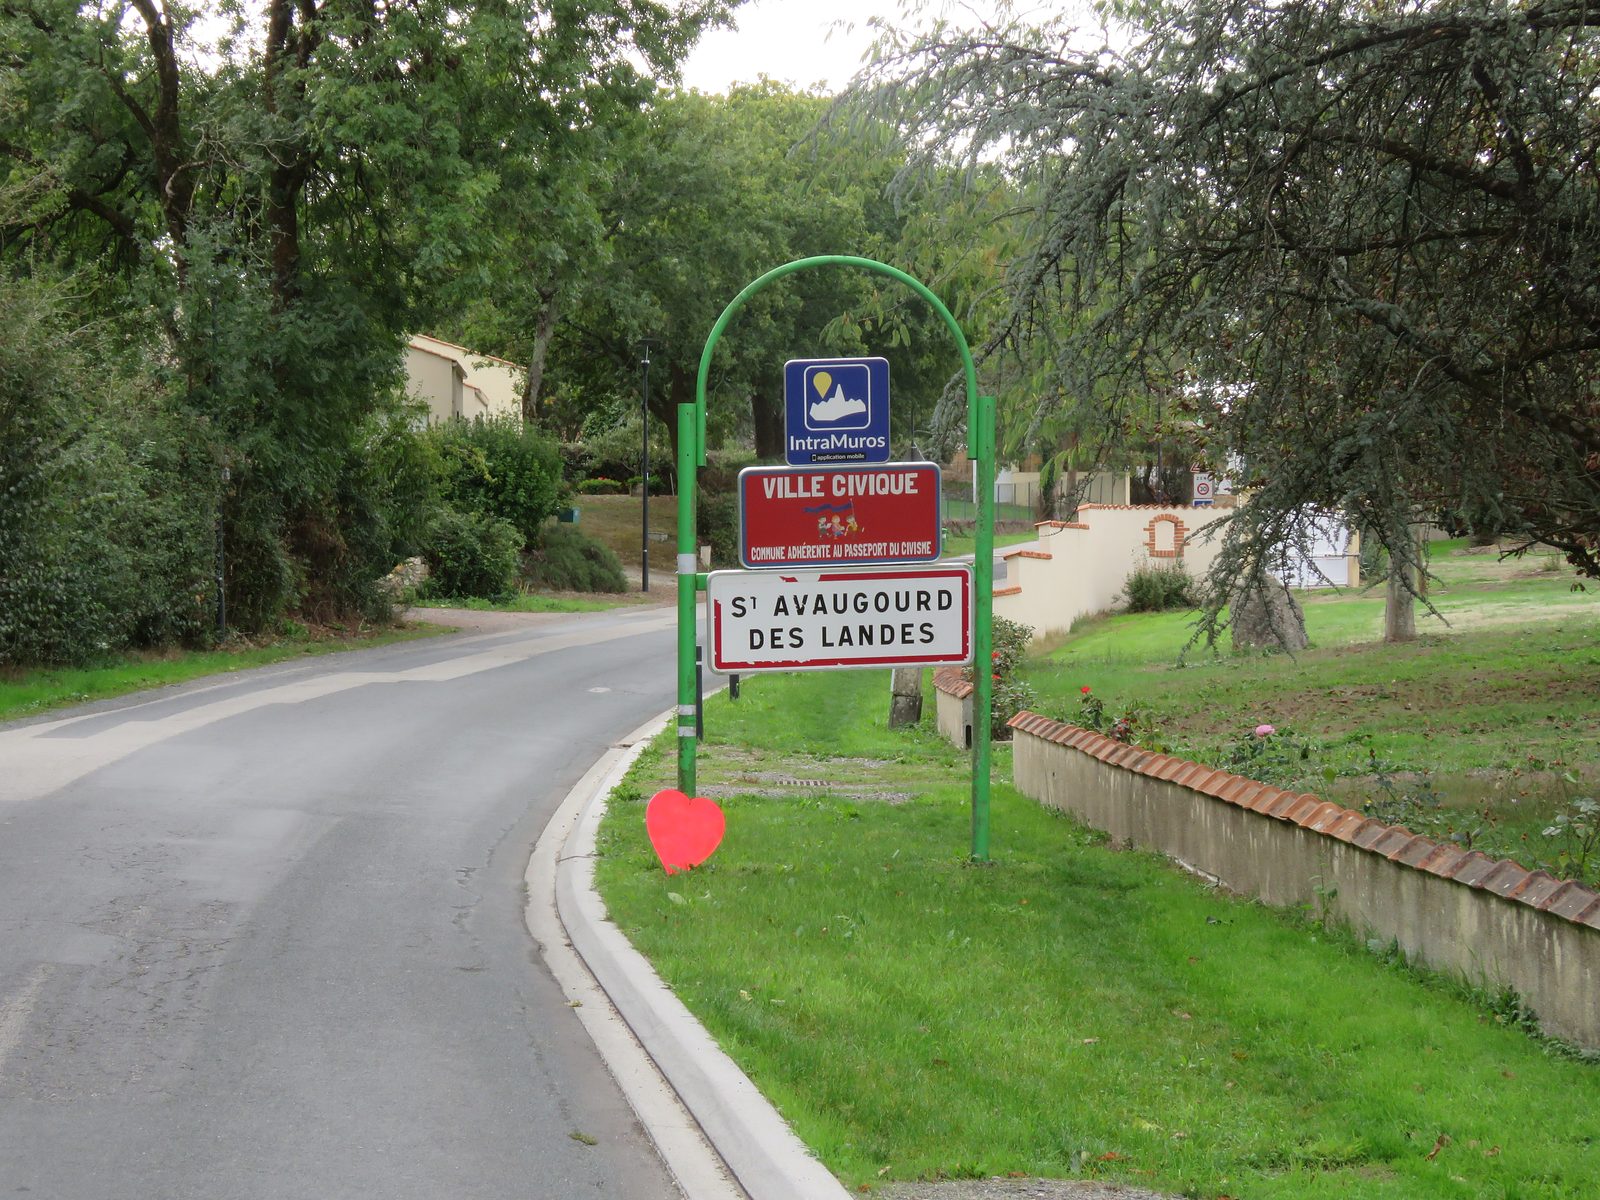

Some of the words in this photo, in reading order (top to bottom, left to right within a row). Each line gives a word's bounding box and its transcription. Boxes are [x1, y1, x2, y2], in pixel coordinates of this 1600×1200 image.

[790, 434, 886, 451] IntraMuros
[817, 453, 846, 461] application
[763, 476, 825, 499] VILLE
[832, 472, 918, 497] CIVIQUE
[751, 546, 785, 561] COMMUNE
[787, 542, 831, 560] ADHÉRENTE
[833, 545, 842, 557] AU
[844, 542, 888, 557] PASSEPORT
[890, 542, 899, 555] DU
[901, 541, 932, 555] CIVISME
[773, 589, 953, 617] AVAUGOURD
[749, 626, 804, 650] DES
[822, 622, 935, 648] LANDES
